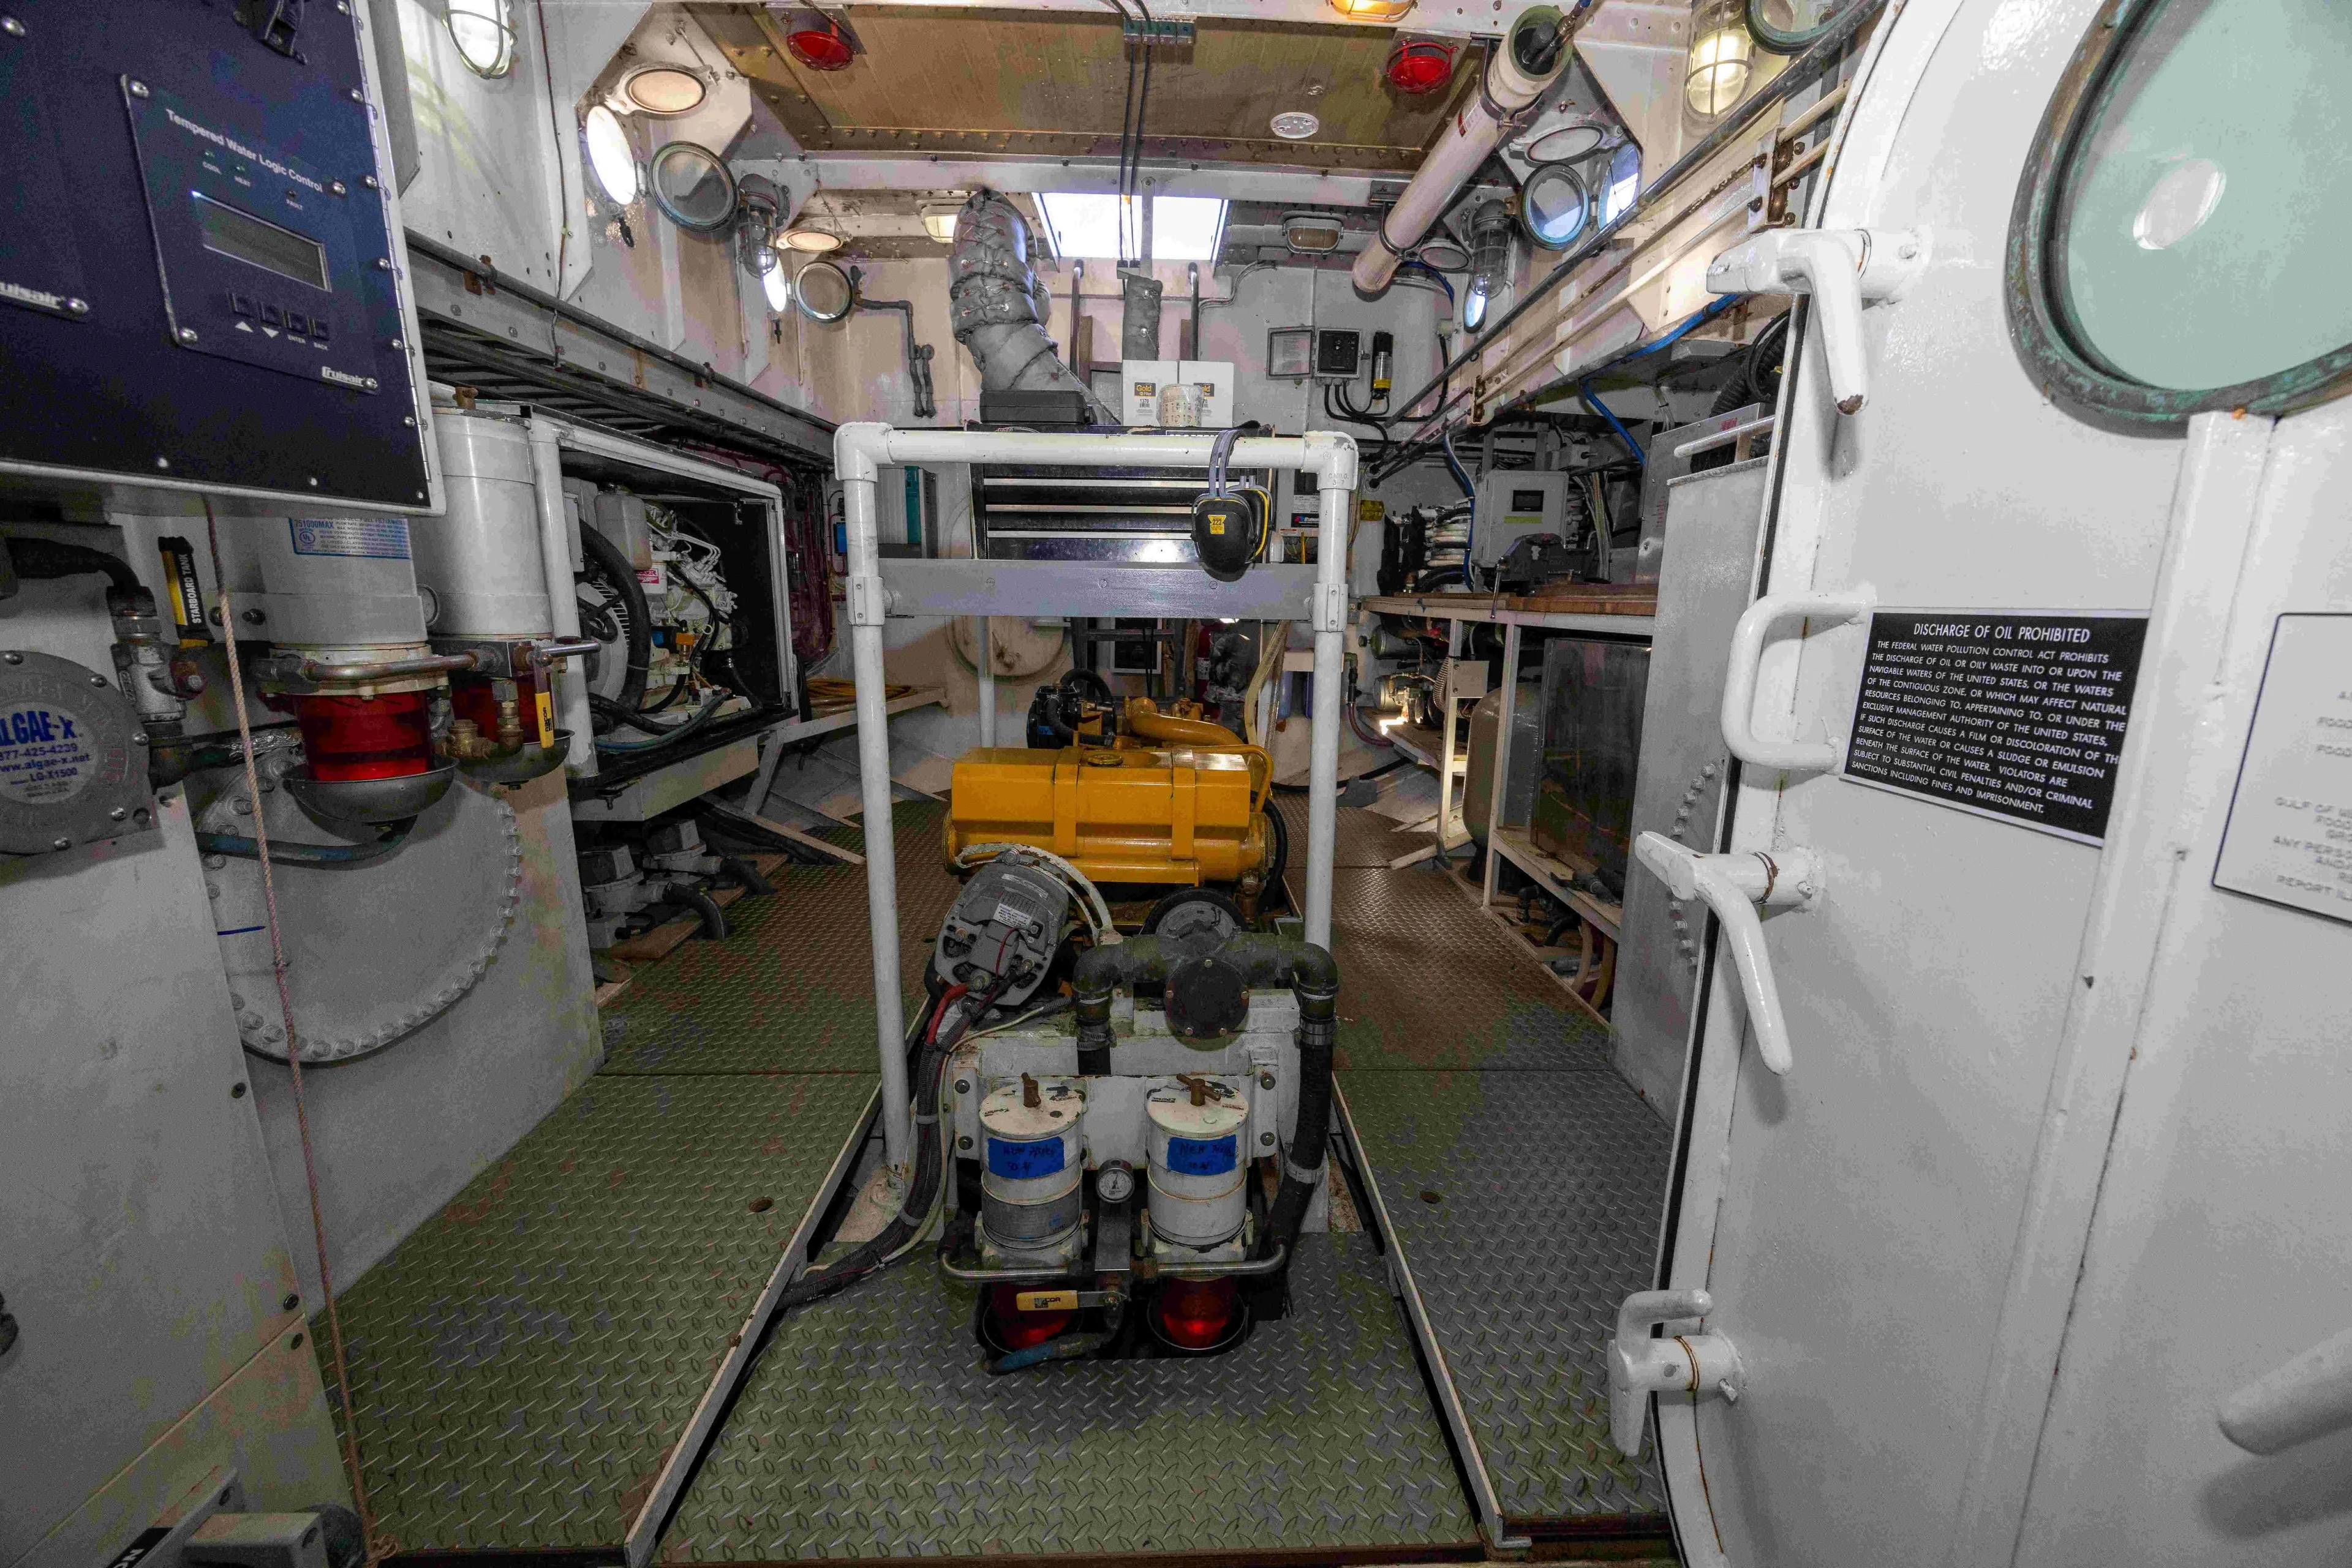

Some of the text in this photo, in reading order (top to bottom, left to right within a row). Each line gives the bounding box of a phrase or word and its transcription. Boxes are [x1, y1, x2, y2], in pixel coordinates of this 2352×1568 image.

[166, 108, 323, 193] Tempered Water Logic Control
[287, 334, 306, 345] ENTER
[178, 553, 202, 624] STARBOARD TANK
[1891, 641, 1917, 650] FEDERAL
[1920, 643, 1943, 652] WATER
[1946, 645, 1989, 655] POLLUTION
[1992, 647, 2034, 658] CONTROL
[2037, 650, 2056, 660] ACT
[2059, 652, 2109, 663] PROHIBITS
[1913, 623, 2090, 643] DISCHARGE OF OIL PROHIBITED
[1869, 665, 1904, 675] NAVIGABLE
[1905, 668, 1932, 678] WATERS
[1949, 673, 1964, 681] THE
[1966, 674, 1996, 685] UNITED
[2033, 680, 2047, 690] OR
[2051, 682, 2070, 692] THE
[2073, 684, 2114, 696] WATERS
[1886, 654, 1923, 664] DISCHARGE
[1954, 659, 1966, 668] OR
[1969, 660, 1986, 669] OILY
[1989, 662, 2018, 672] WASTE
[2022, 665, 2045, 674] INTO
[2048, 666, 2063, 676] OR
[2067, 668, 2097, 679] UPON
[2101, 670, 2122, 680] THE
[1864, 690, 1901, 701] RESOURCES
[1903, 695, 1946, 707] BELONGING
[1964, 702, 2024, 717] APPERTAINING
[2047, 713, 2062, 723] OR
[2065, 715, 2100, 728] UNDER
[2104, 720, 2125, 731] THE
[1893, 680, 1940, 692] CONTIGUOUS
[1970, 688, 1982, 698] OR
[1985, 690, 2016, 701] WHICH
[2019, 694, 2039, 704] MAY
[2042, 696, 2077, 709] AFFECT
[2081, 701, 2127, 715] NATURAL
[1863, 701, 1893, 713] EXCLUSIVE
[1896, 706, 1947, 721] MANAGEMENT
[1950, 714, 1994, 728] AUTHORITY
[1996, 721, 2009, 730] OF
[2013, 723, 2030, 734] THE
[2034, 726, 2068, 739] UNITED
[1858, 725, 2105, 778] SURFACE OF THE WATER OR CAUSES A SLUDGE OR EMULSION
[1868, 715, 1885, 724] SUCH
[1887, 718, 1925, 731] DISCHARGE
[1928, 725, 1956, 736] CAUSES
[1959, 729, 1966, 738] A
[1969, 731, 1986, 741] FILM
[1989, 734, 2002, 744] OR
[2006, 737, 2080, 757] DISCOLORATION
[2084, 750, 2100, 761] OF
[2104, 753, 2119, 764] TH
[1851, 761, 1888, 775] SANCTIONS
[1890, 769, 1928, 785] INCLUDING
[1931, 779, 1953, 791] FINES
[1955, 785, 1973, 796] AND
[1853, 749, 2094, 809] SUBJECT TO SUBSTANTIAL CIVIL PENALTIES AND/OR CRIMINAL
[1856, 737, 1883, 749] BENEATH
[1885, 743, 1898, 752] THE
[1901, 746, 1929, 759] SURFACE
[1932, 752, 1942, 761] OF
[1945, 755, 1960, 765] THE
[1998, 765, 2046, 782] VIOLATORS
[2049, 775, 2067, 787] ARE
